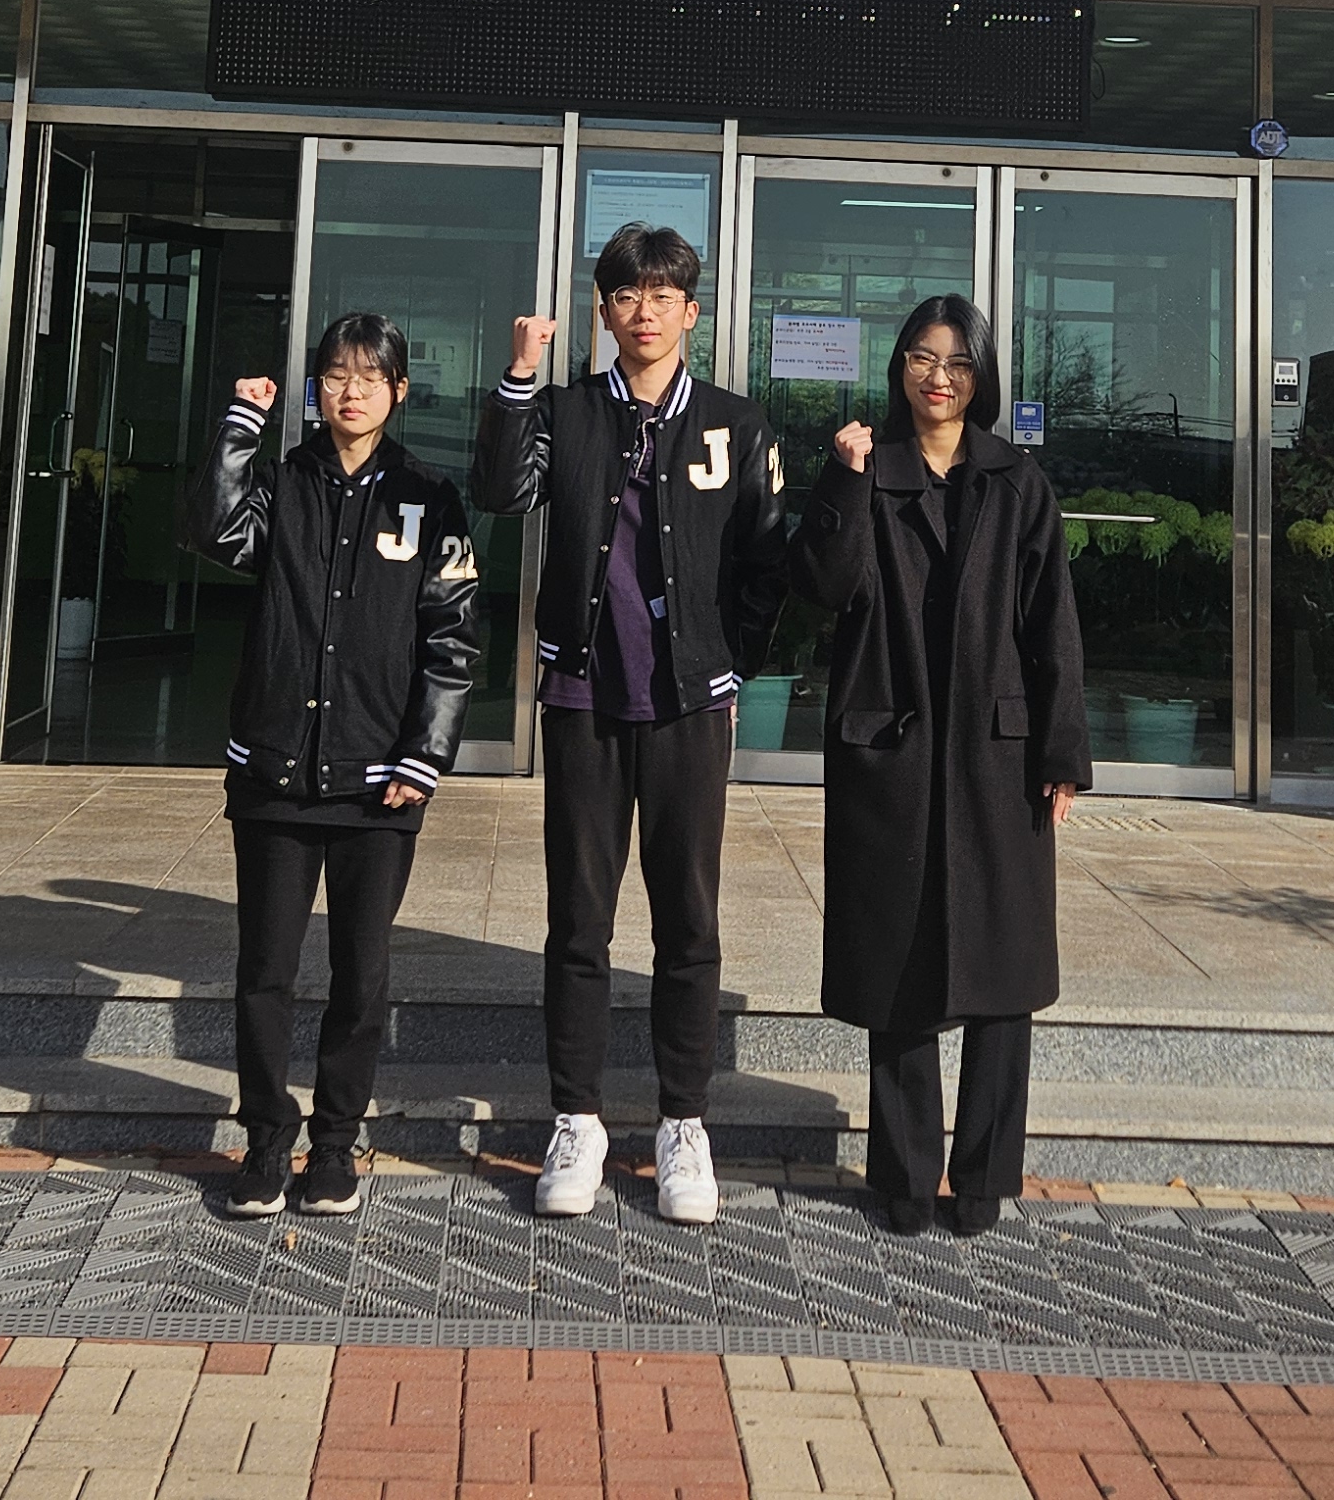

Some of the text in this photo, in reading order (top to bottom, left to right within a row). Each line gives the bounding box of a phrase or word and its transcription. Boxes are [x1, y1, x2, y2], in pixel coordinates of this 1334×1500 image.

[1257, 130, 1283, 145] ADT
[688, 427, 731, 491] J
[376, 503, 426, 562] J
[439, 535, 479, 580] 22
